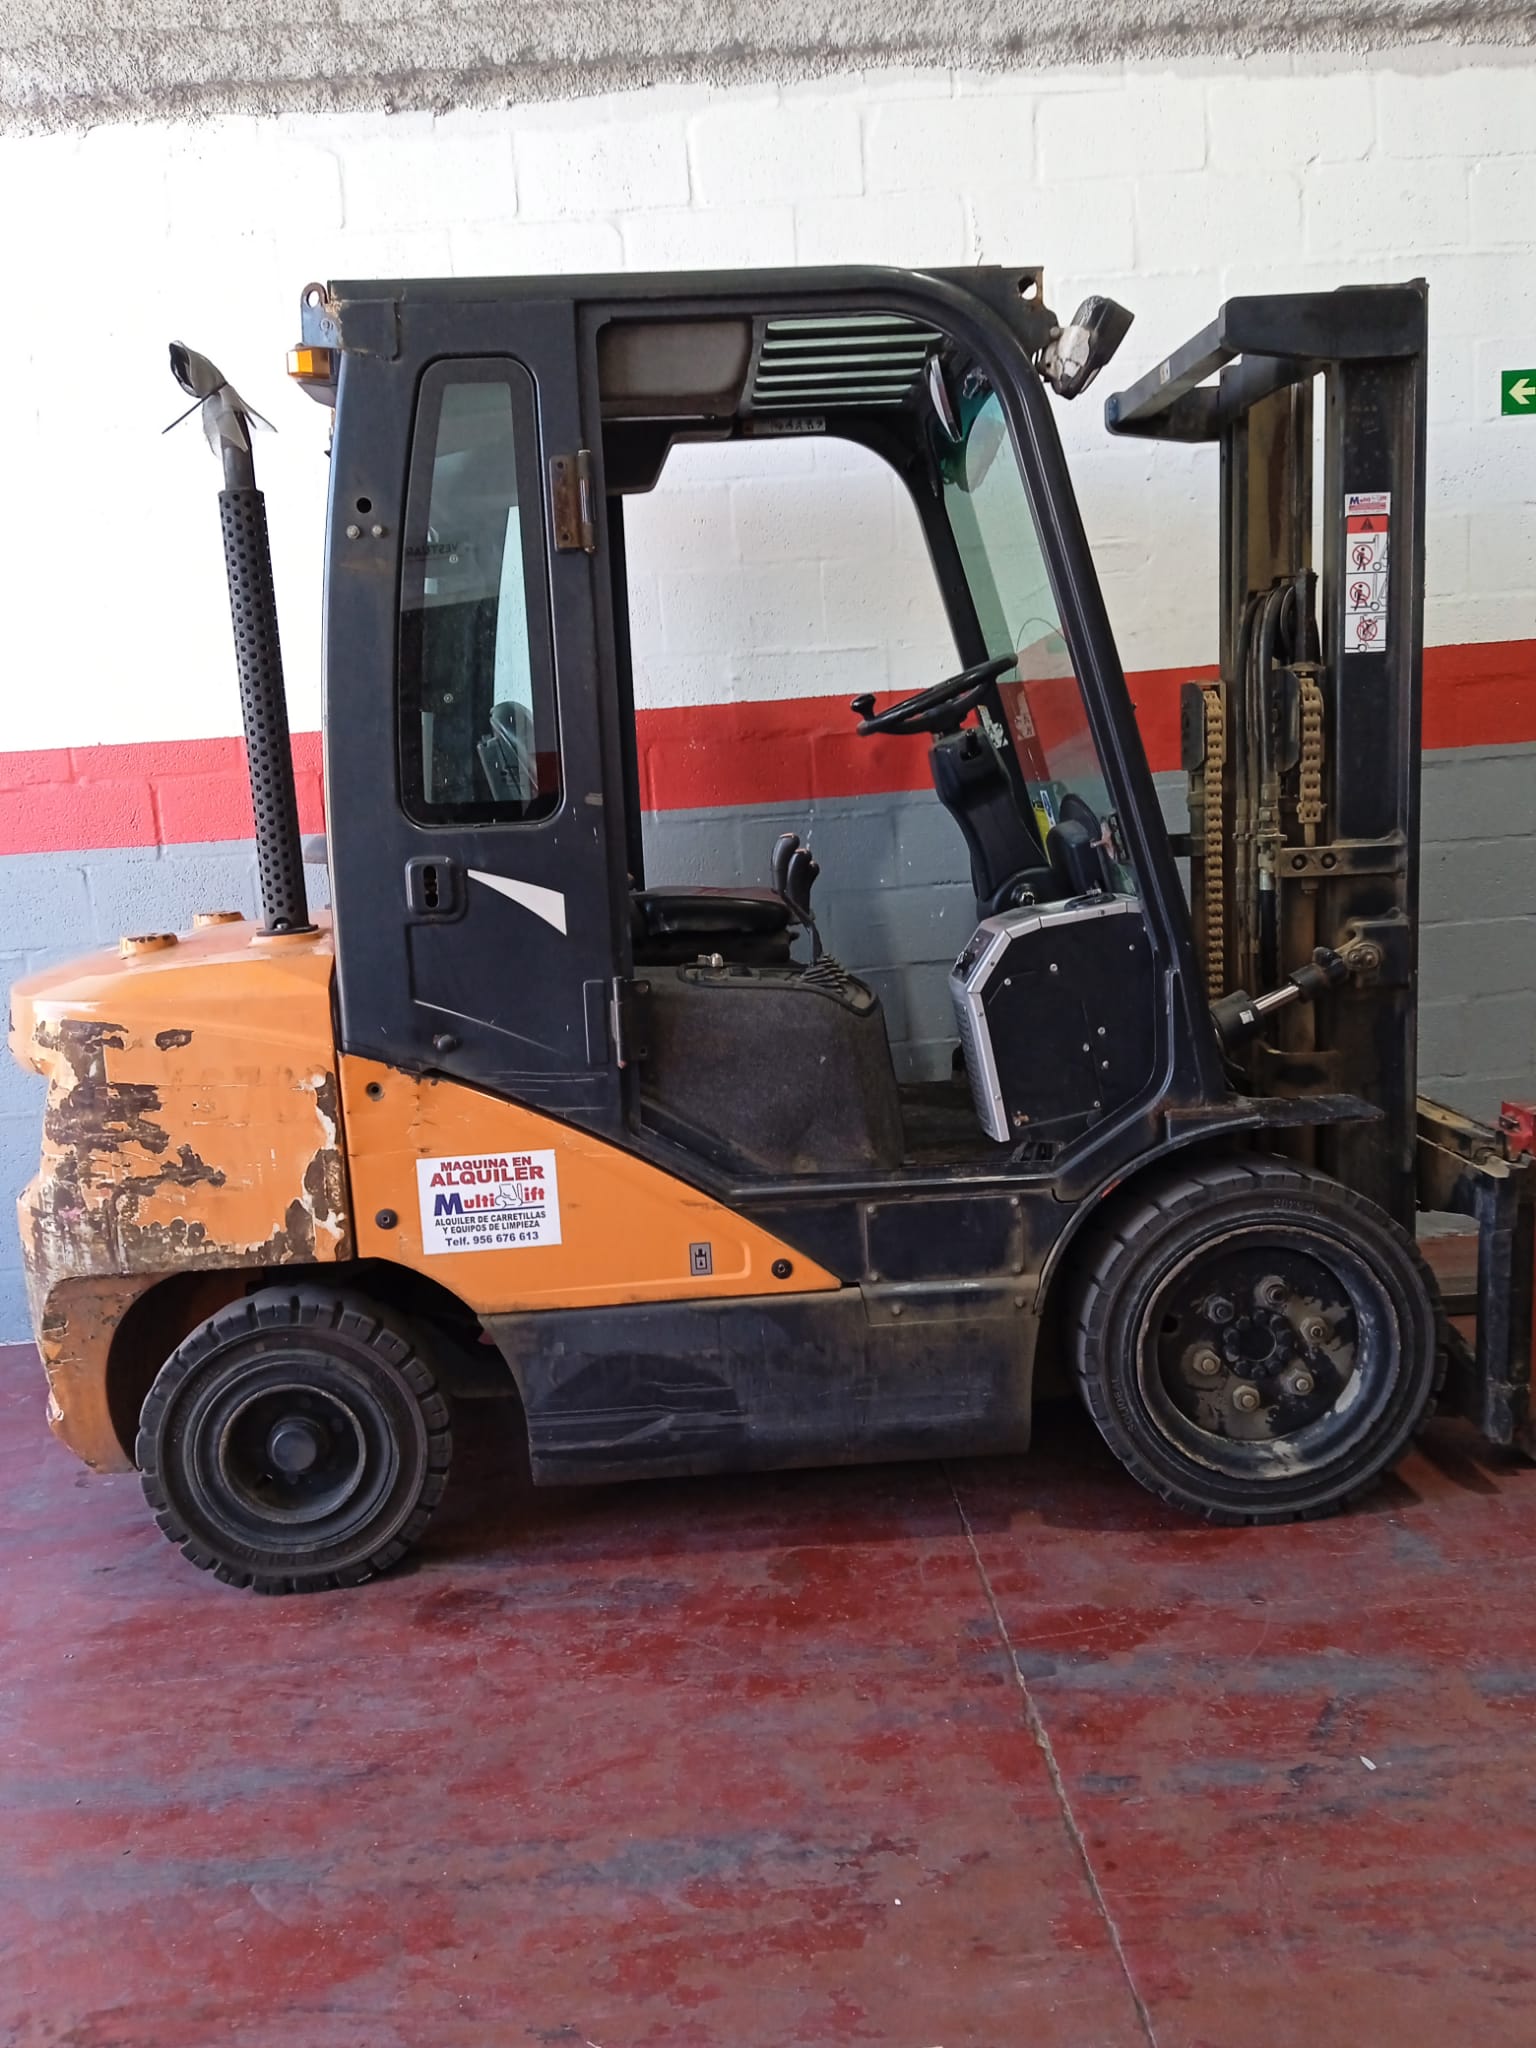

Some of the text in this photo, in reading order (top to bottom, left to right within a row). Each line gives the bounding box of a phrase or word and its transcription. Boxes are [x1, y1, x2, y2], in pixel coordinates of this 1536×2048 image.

[440, 1156, 531, 1172] MAQUINA EN
[430, 1165, 545, 1187] ALQUILER
[435, 1211, 546, 1227] ALQUILER DE CARRETILLAS
[442, 1219, 540, 1235] Y EQUIPOS DE LIMPIEZA
[445, 1231, 539, 1247] Telf. 956 676 613
